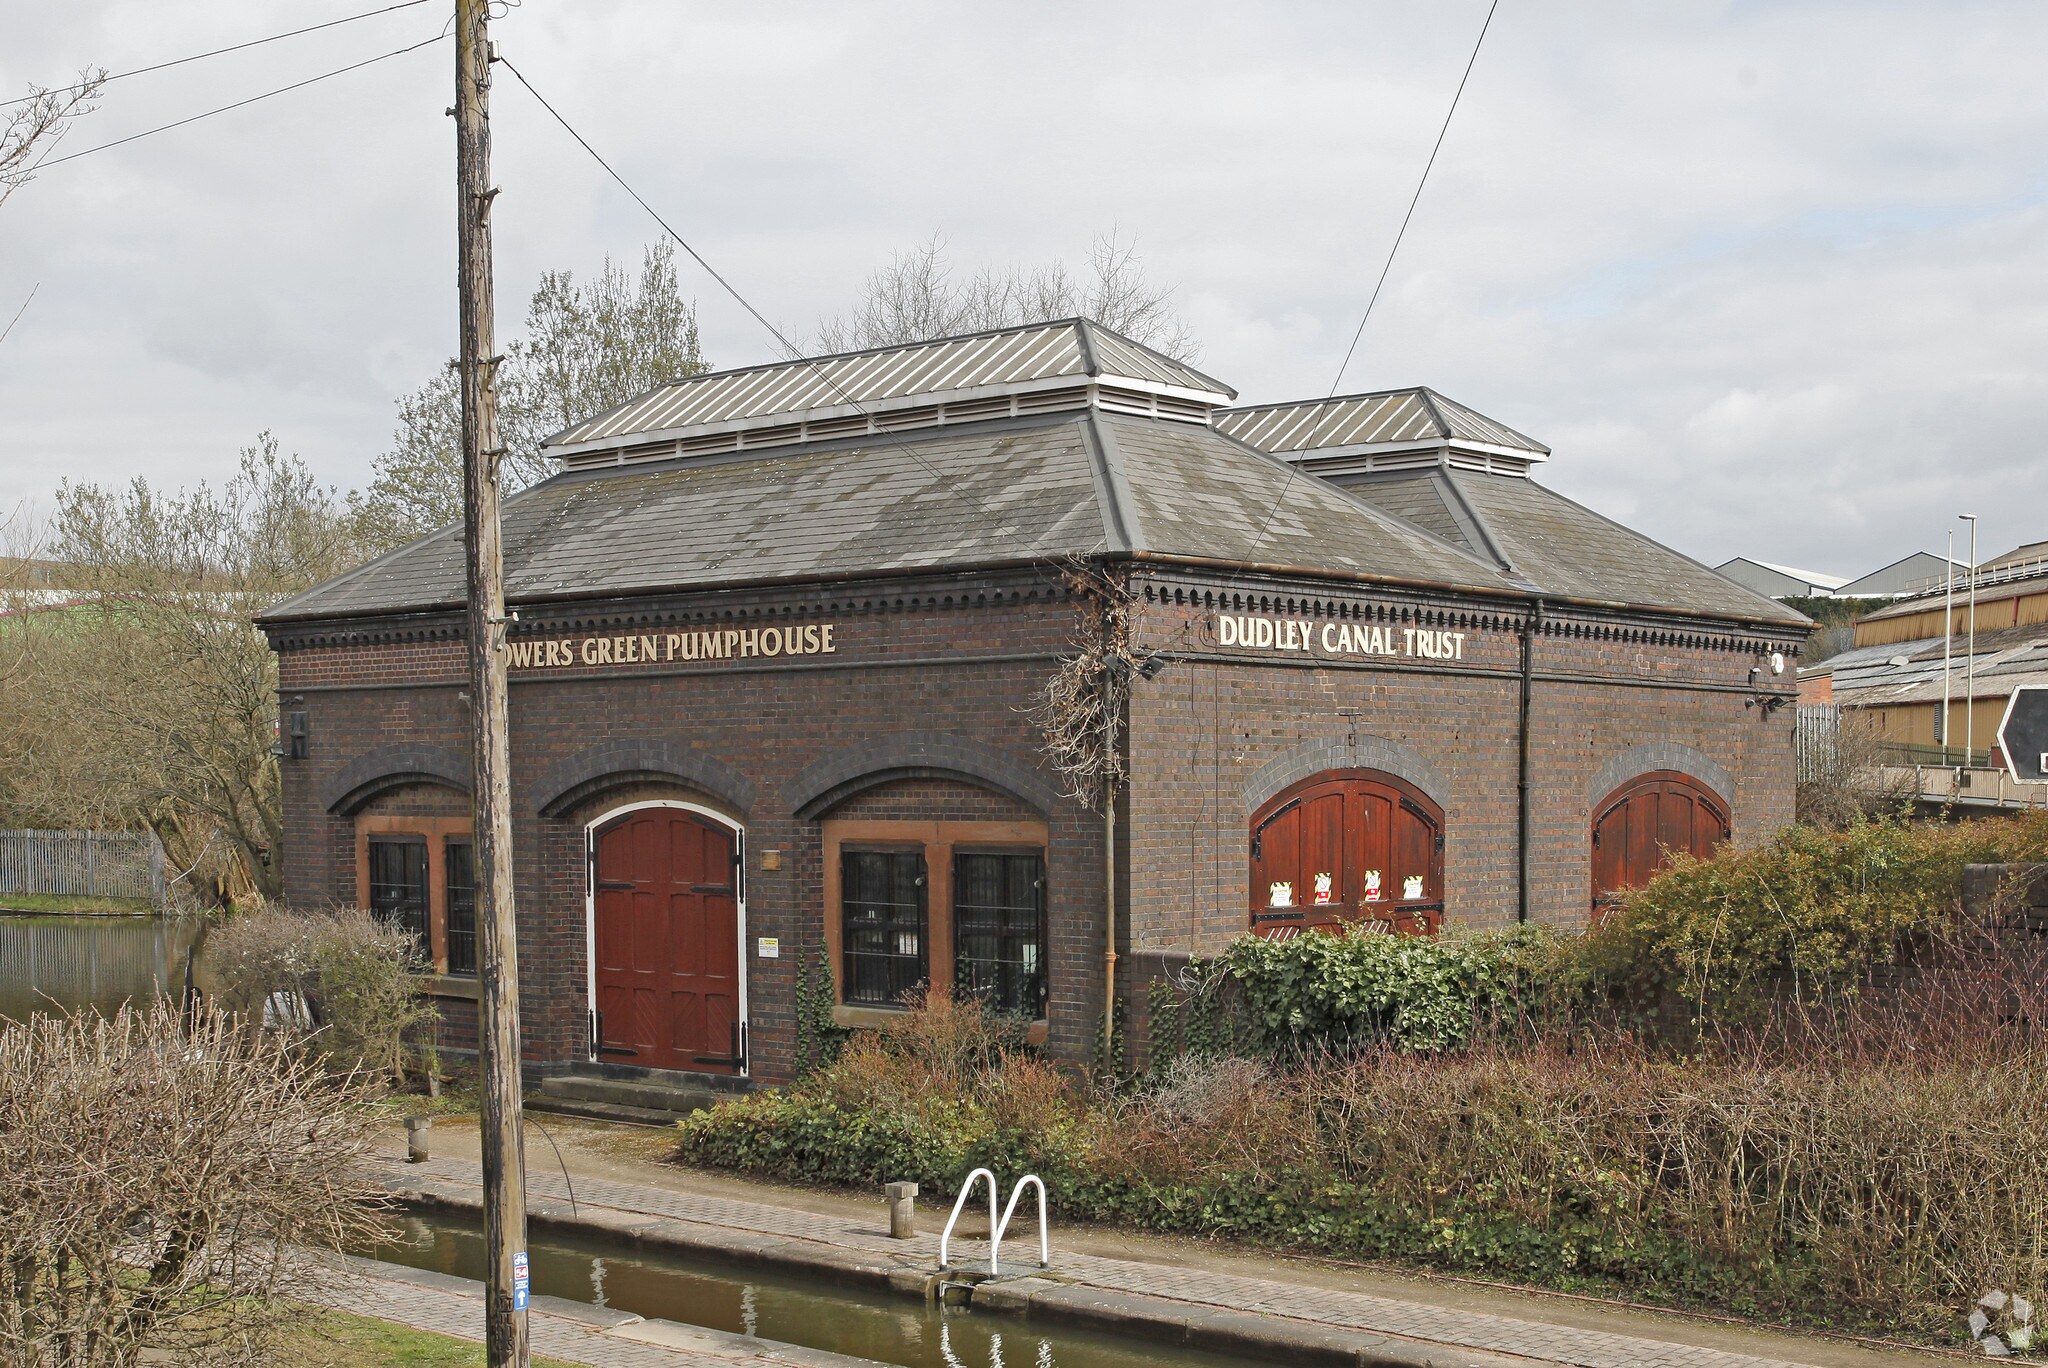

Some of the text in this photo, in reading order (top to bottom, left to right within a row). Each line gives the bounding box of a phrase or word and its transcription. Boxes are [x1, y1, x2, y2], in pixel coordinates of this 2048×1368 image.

[581, 634, 658, 666] GREEN
[666, 624, 836, 662] PUMPHOUSE
[1219, 615, 1465, 660] DUDLEY CANAL TRUST
[516, 1266, 528, 1278] 54
